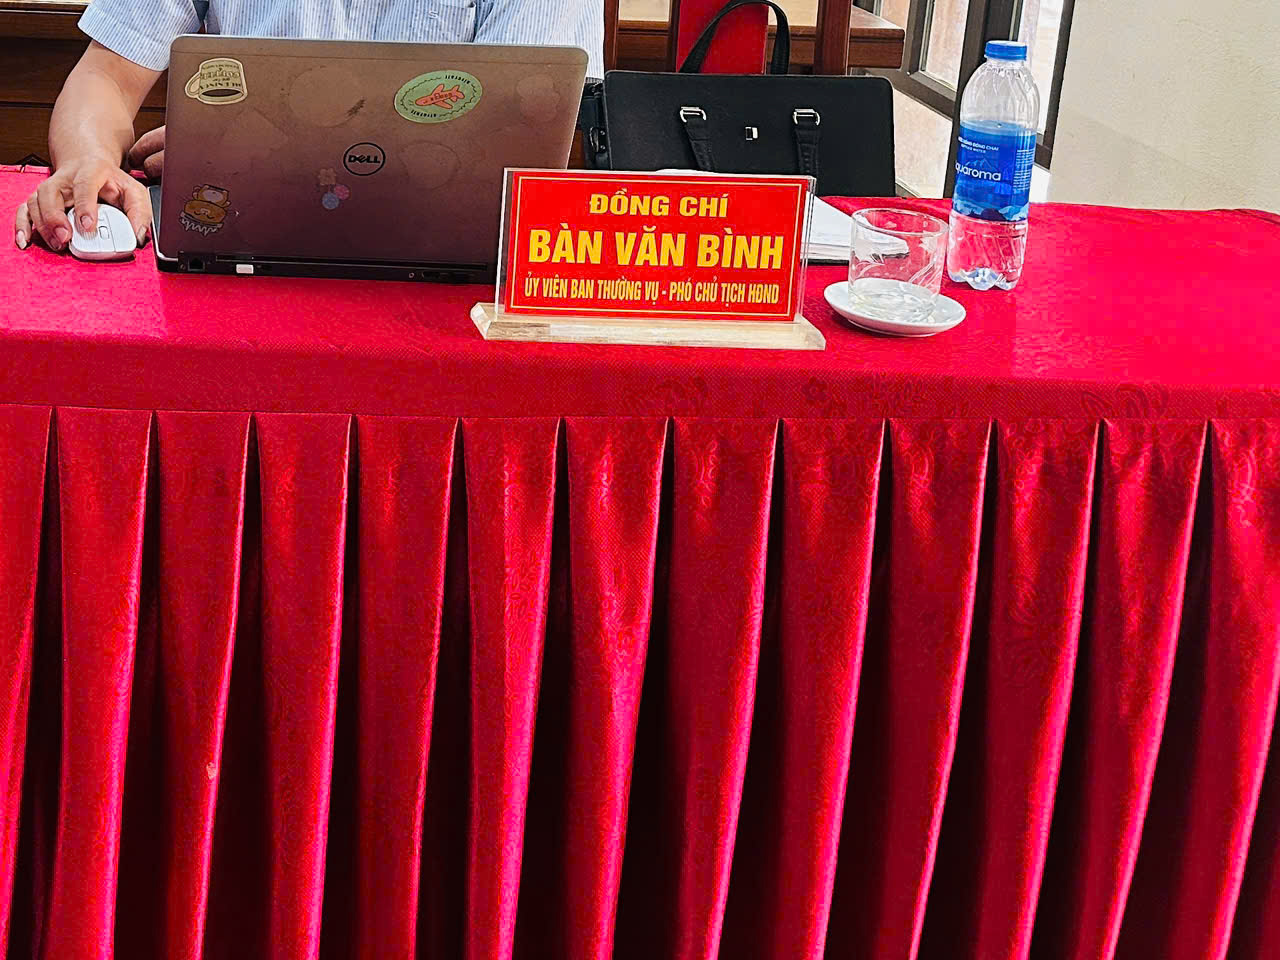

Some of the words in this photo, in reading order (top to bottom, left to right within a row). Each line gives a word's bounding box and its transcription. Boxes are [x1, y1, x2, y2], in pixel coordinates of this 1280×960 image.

[348, 155, 380, 163] DELL
[955, 162, 1001, 181] quaroma
[589, 188, 670, 217] ĐỒNG
[679, 193, 729, 218] CHÍ
[528, 223, 603, 264] BÀN
[615, 225, 687, 267] VĂN
[696, 227, 784, 269] BÌNH
[524, 271, 540, 297] ỦY
[542, 274, 568, 298] VIÊN
[570, 279, 594, 299] BAN
[597, 275, 642, 301] THƯỜNG
[644, 281, 659, 306] VỤ
[669, 277, 693, 301] PHÓ
[695, 276, 719, 302] CHỦ
[720, 283, 746, 307] TỊCH
[748, 284, 780, 304] HĐND
